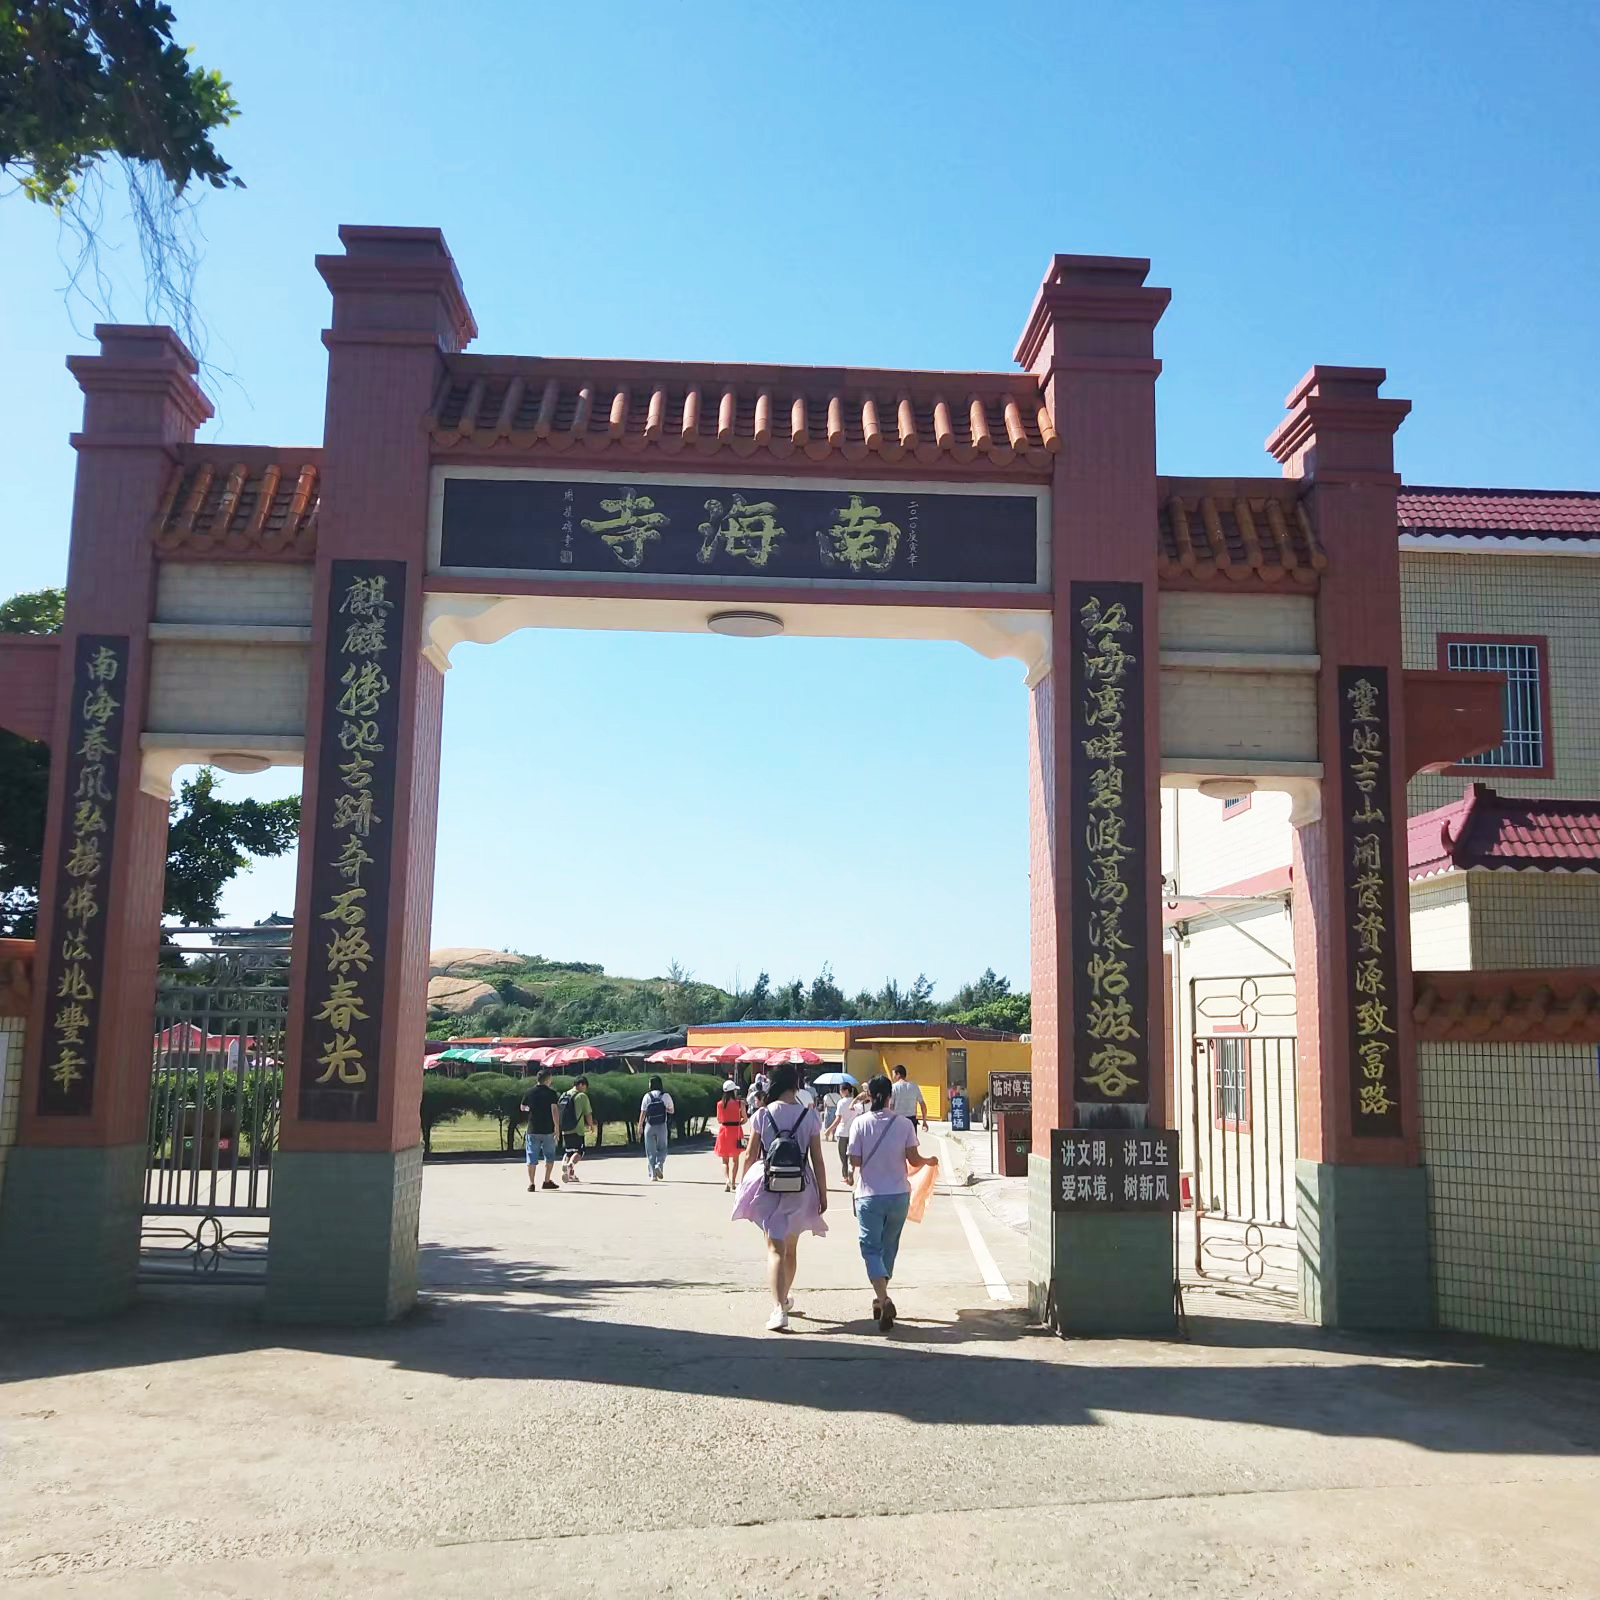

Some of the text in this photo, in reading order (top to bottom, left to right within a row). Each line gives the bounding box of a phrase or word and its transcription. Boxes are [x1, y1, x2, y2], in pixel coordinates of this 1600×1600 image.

[992, 1080, 1031, 1097] 临时停车
[952, 1097, 964, 1129] 停车场
